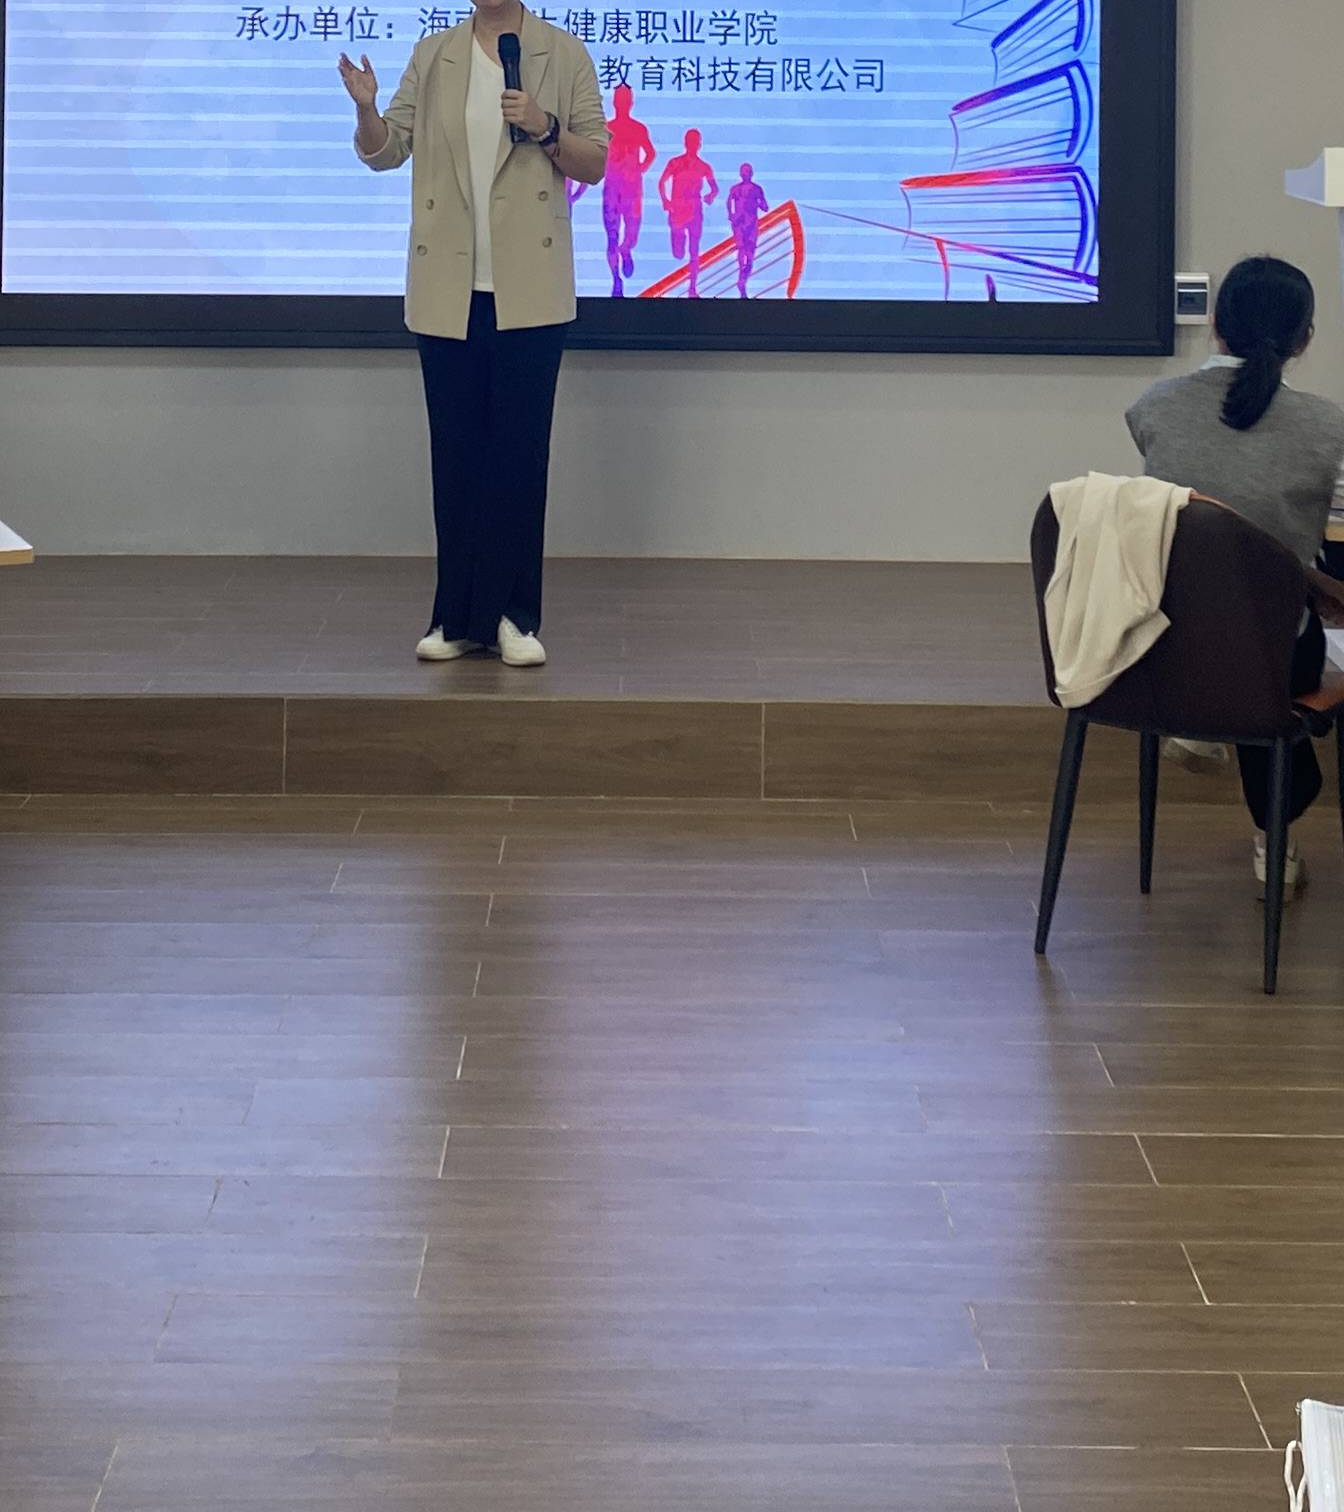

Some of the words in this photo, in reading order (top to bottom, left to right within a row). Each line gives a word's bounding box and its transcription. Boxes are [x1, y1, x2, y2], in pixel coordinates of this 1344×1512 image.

[599, 55, 885, 93] 教育科技有限公司
